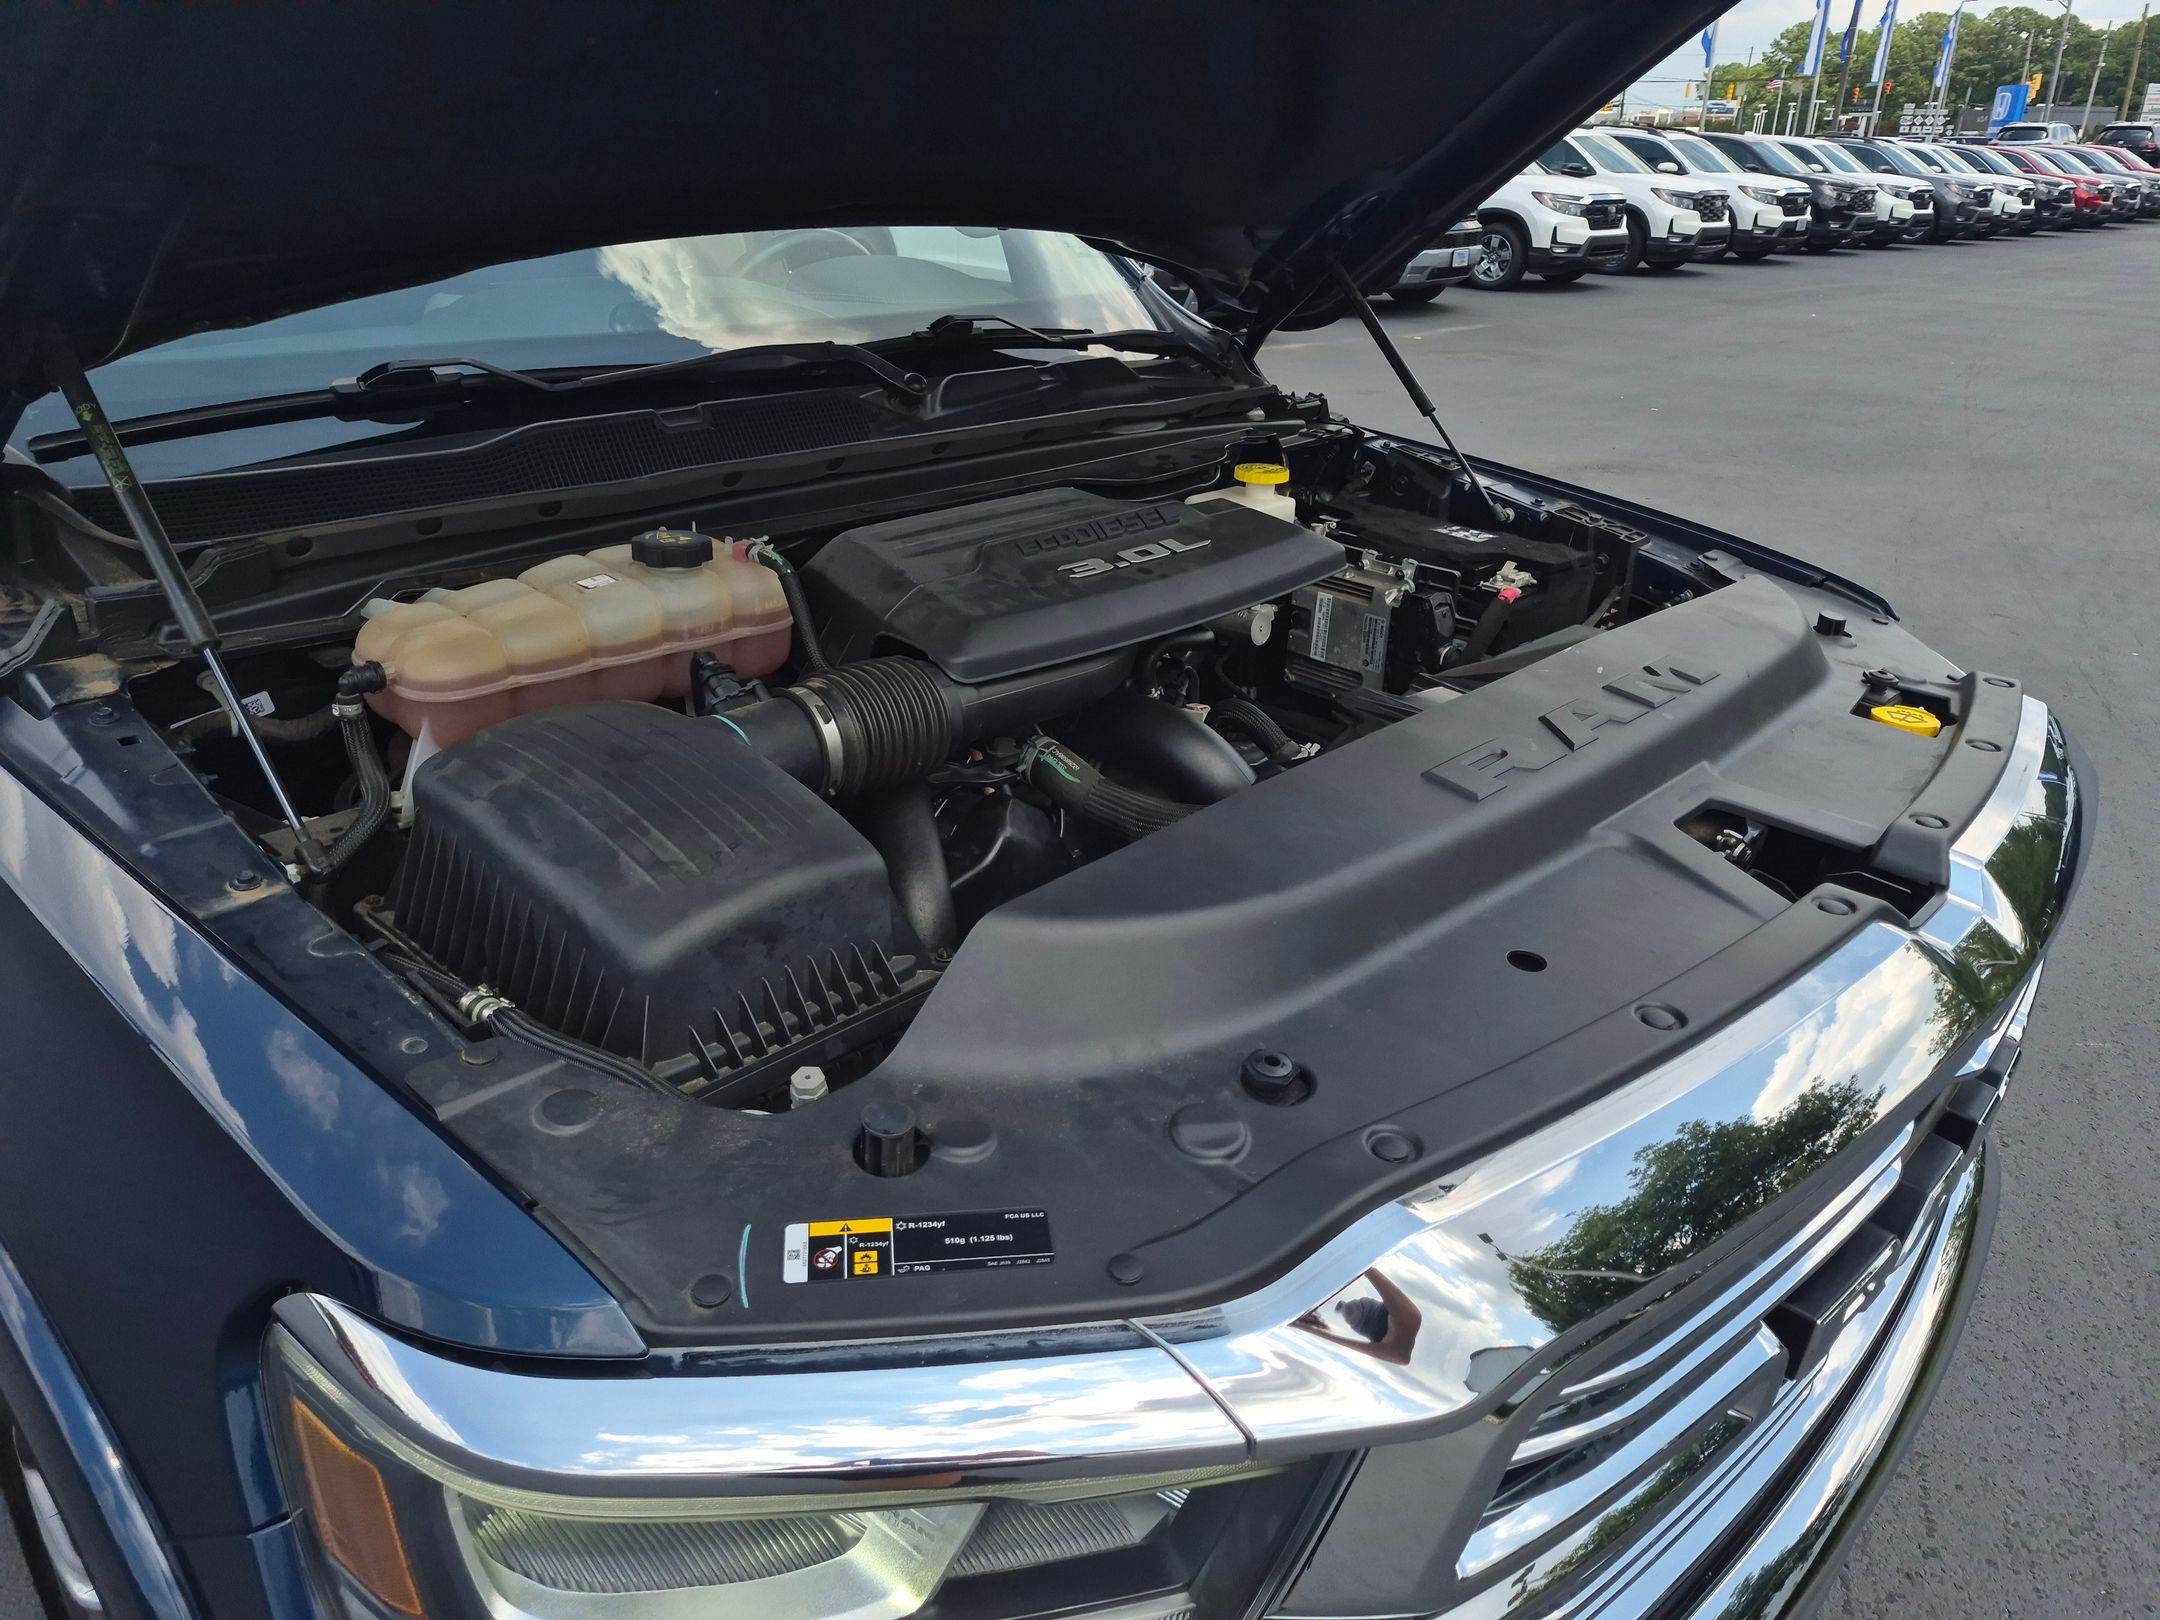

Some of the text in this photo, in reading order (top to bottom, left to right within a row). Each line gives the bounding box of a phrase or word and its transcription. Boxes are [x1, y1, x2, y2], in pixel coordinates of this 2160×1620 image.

[1016, 508, 1181, 556] ECODIESEL
[1057, 538, 1211, 578] 3.0L
[1420, 654, 1721, 802] RAM
[908, 1220, 946, 1229] R-1234yf
[859, 1240, 889, 1248] R-1234yf
[944, 1233, 1013, 1245] 510g (1.125 lbs)
